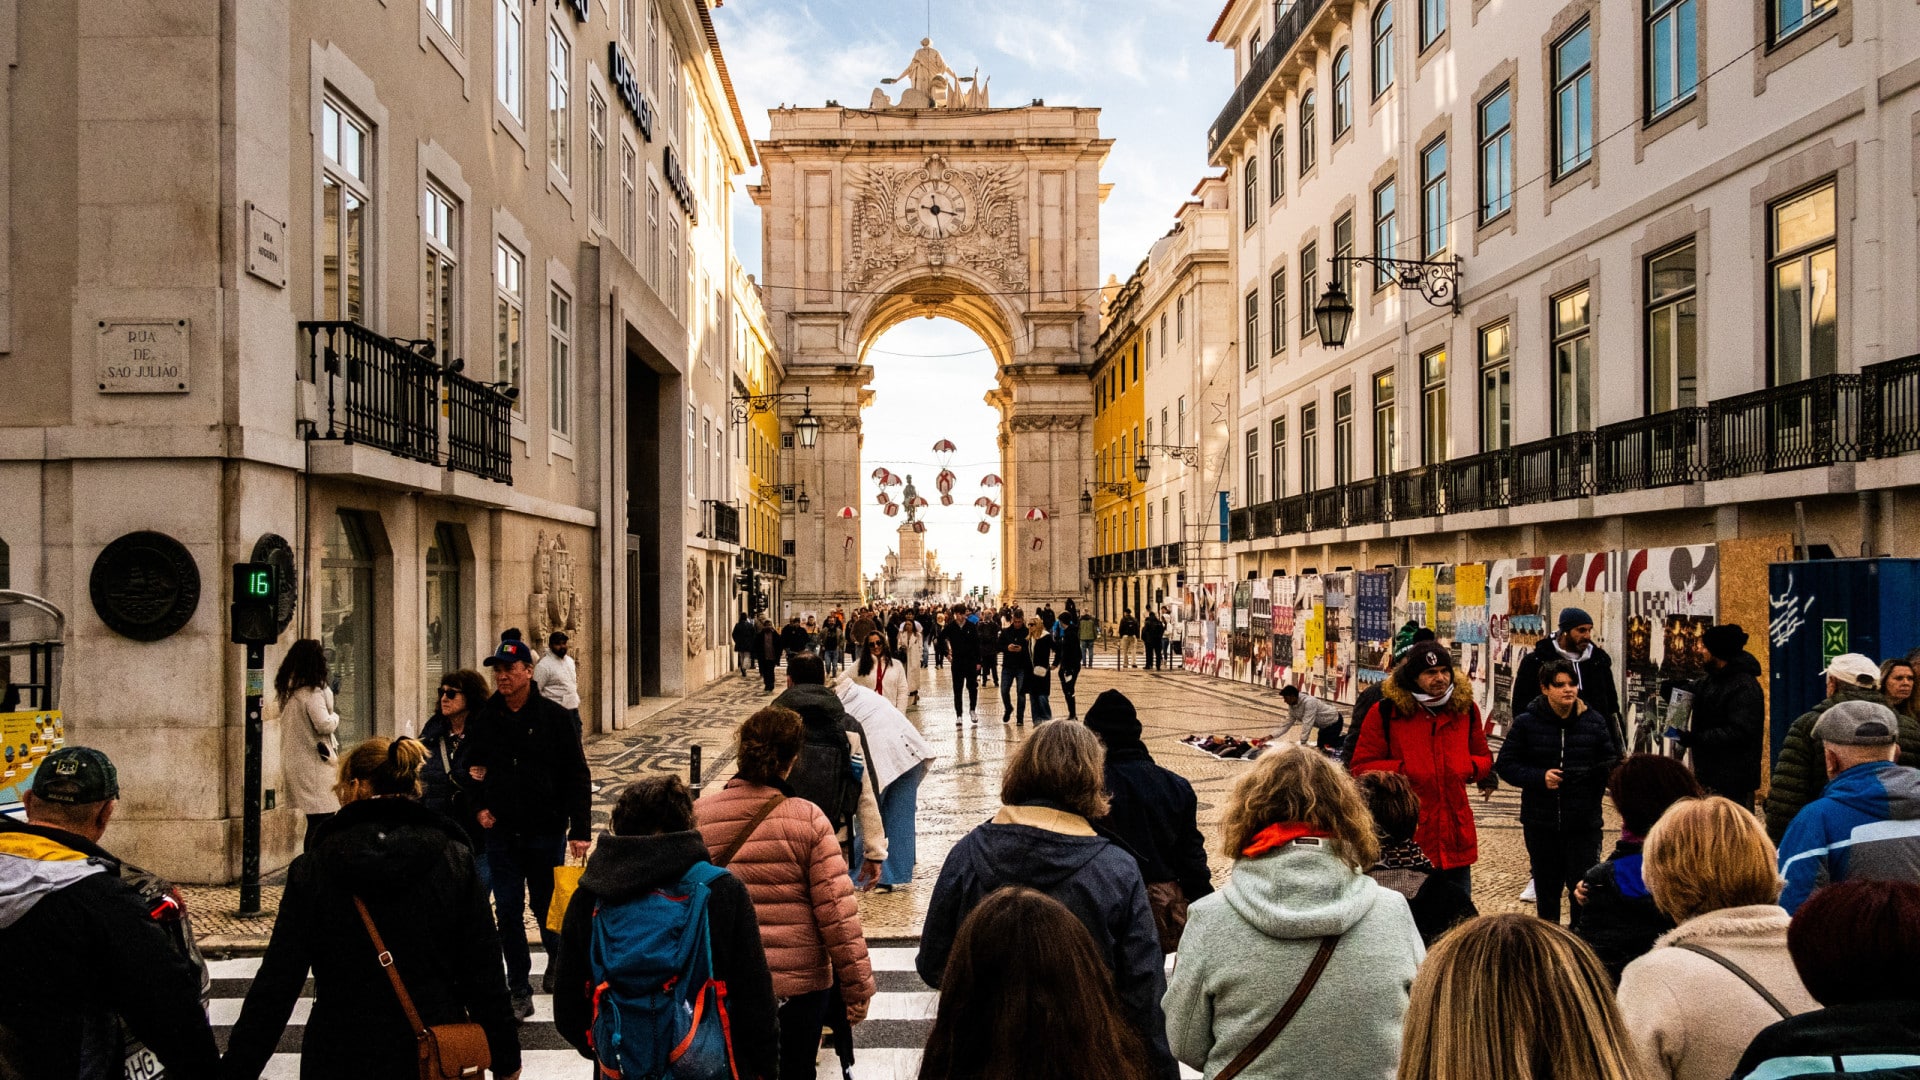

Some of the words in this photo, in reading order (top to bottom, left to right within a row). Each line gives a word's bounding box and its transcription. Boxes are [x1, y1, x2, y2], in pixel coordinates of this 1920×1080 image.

[612, 42, 652, 138] DESIGN
[263, 231, 274, 244] RUA
[258, 246, 278, 264] AUGUSTA
[128, 331, 157, 343] RUA
[133, 348, 151, 361] DE
[135, 362, 178, 378] JULIÃO
[251, 572, 268, 594] 16
